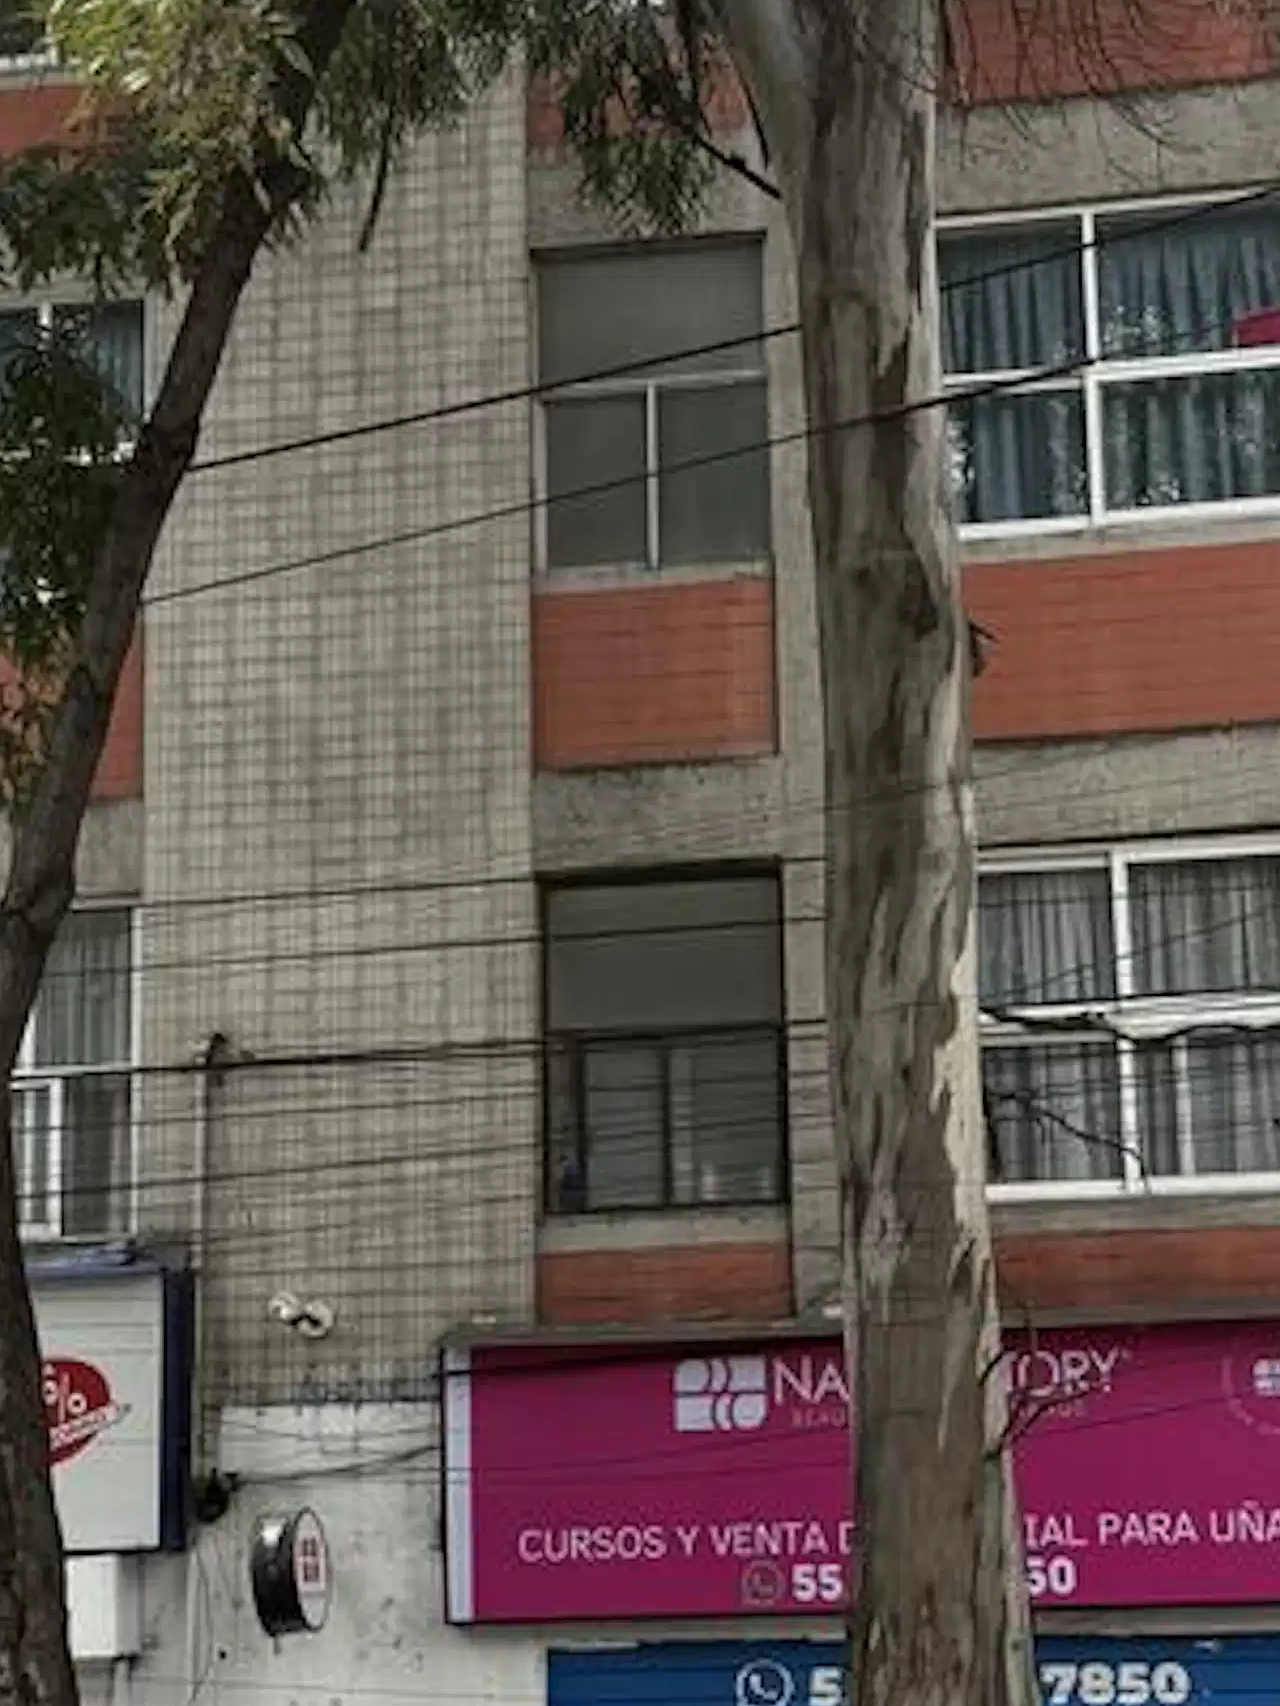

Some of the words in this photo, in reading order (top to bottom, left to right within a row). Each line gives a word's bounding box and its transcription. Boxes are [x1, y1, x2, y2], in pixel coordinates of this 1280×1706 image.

[518, 1526, 668, 1563] CURSOS
[676, 1524, 700, 1556] Y
[710, 1521, 830, 1556] VENTA
[1097, 1509, 1200, 1546] PARA
[791, 1562, 843, 1603] 55
[1039, 1661, 1191, 1706] 7850
